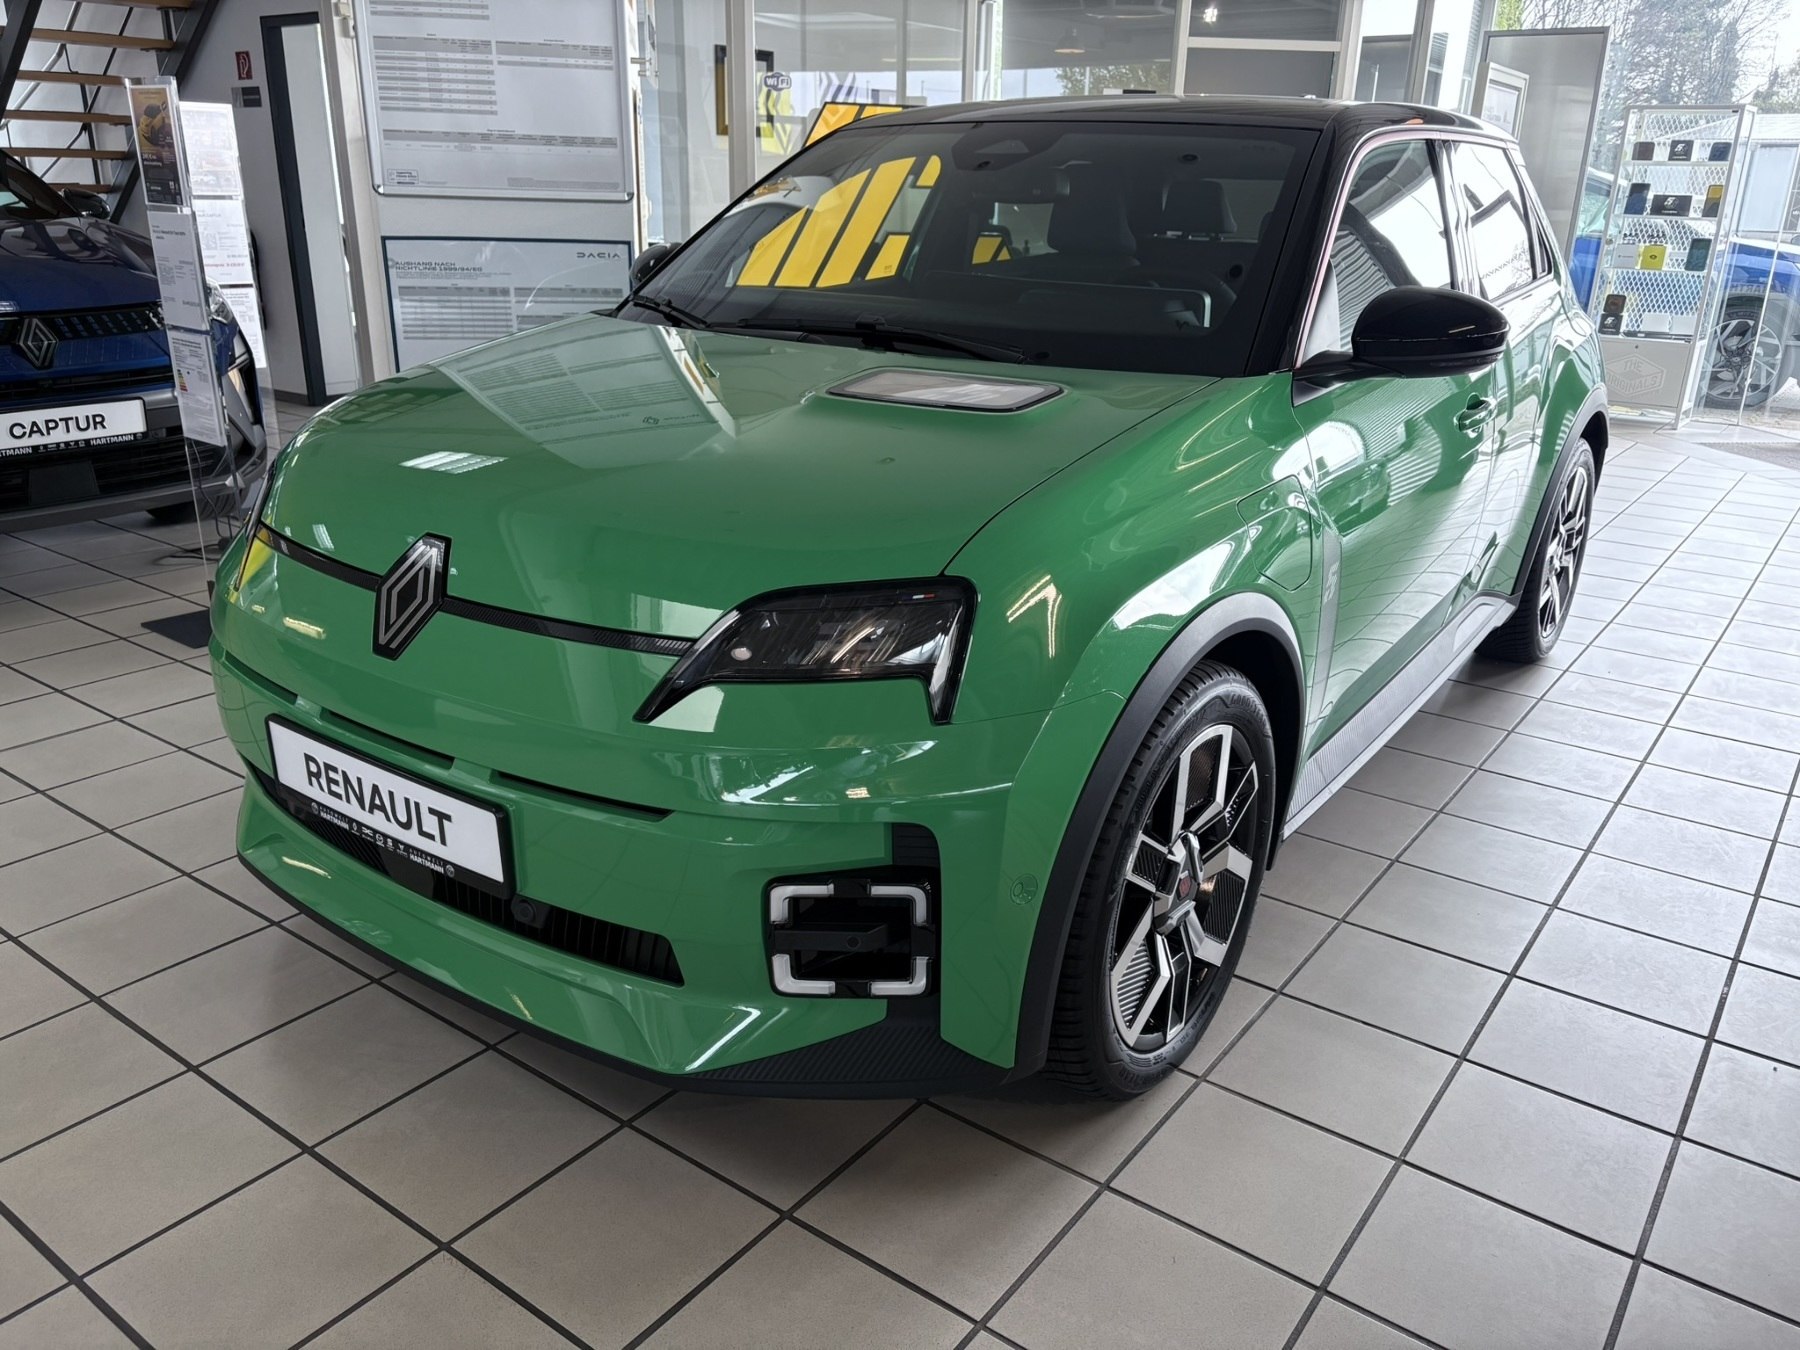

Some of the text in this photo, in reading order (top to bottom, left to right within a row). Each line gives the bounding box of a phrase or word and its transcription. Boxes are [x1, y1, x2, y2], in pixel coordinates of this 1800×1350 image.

[1623, 358, 1644, 373] THE
[9, 413, 108, 440] CAPTUR
[90, 433, 135, 446] HARTMANN
[0, 446, 33, 458] TMANN
[303, 752, 452, 847] RENAULT
[320, 812, 350, 831] HARTMANN
[409, 853, 444, 874] HARTMANN
